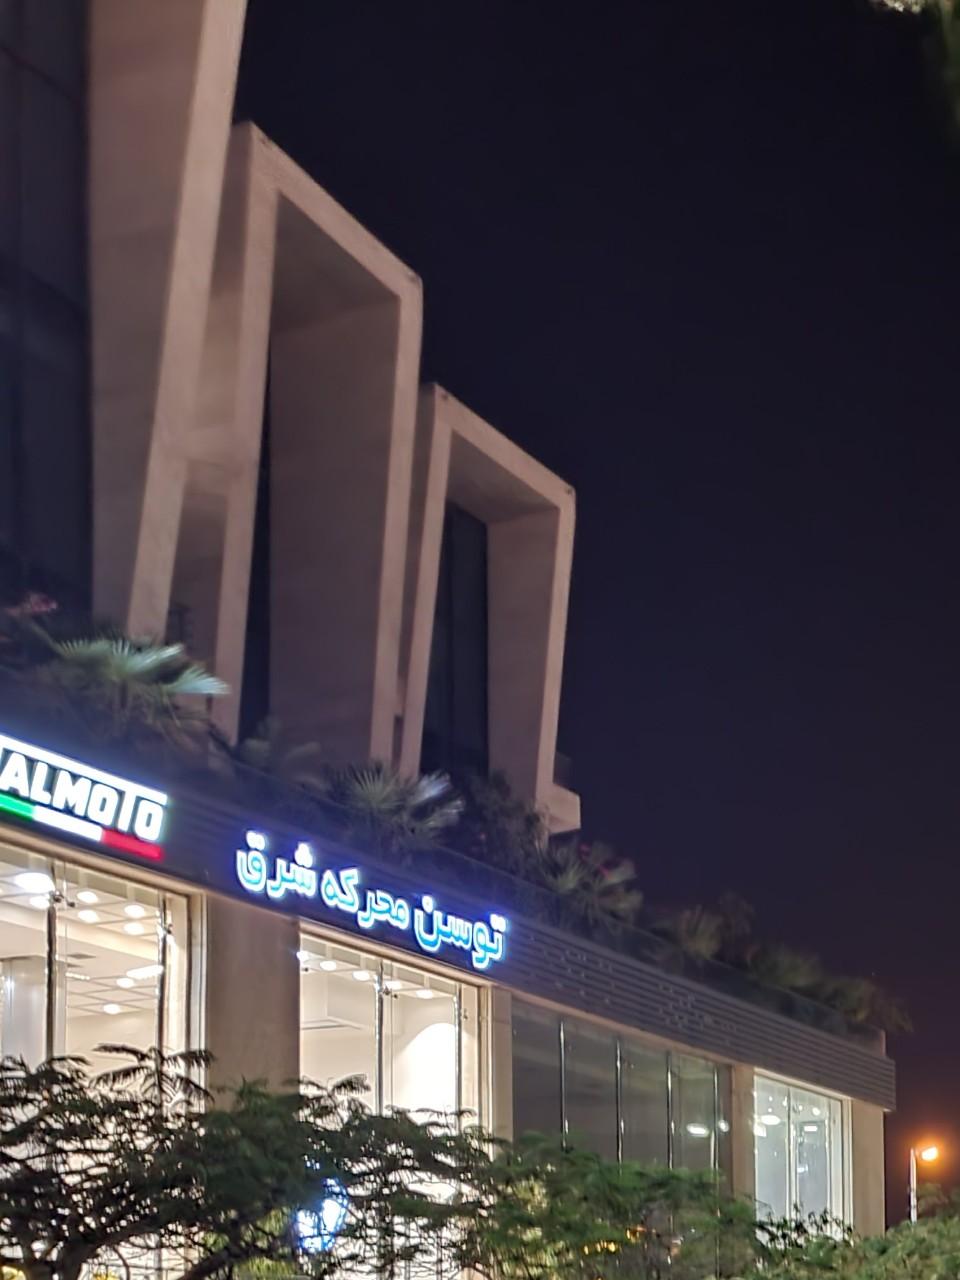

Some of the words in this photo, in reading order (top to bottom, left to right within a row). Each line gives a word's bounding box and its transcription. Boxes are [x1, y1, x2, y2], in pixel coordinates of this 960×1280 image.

[0, 738, 168, 842] ALMOTO
[235, 829, 317, 899] شرق
[413, 896, 508, 970] توسن
